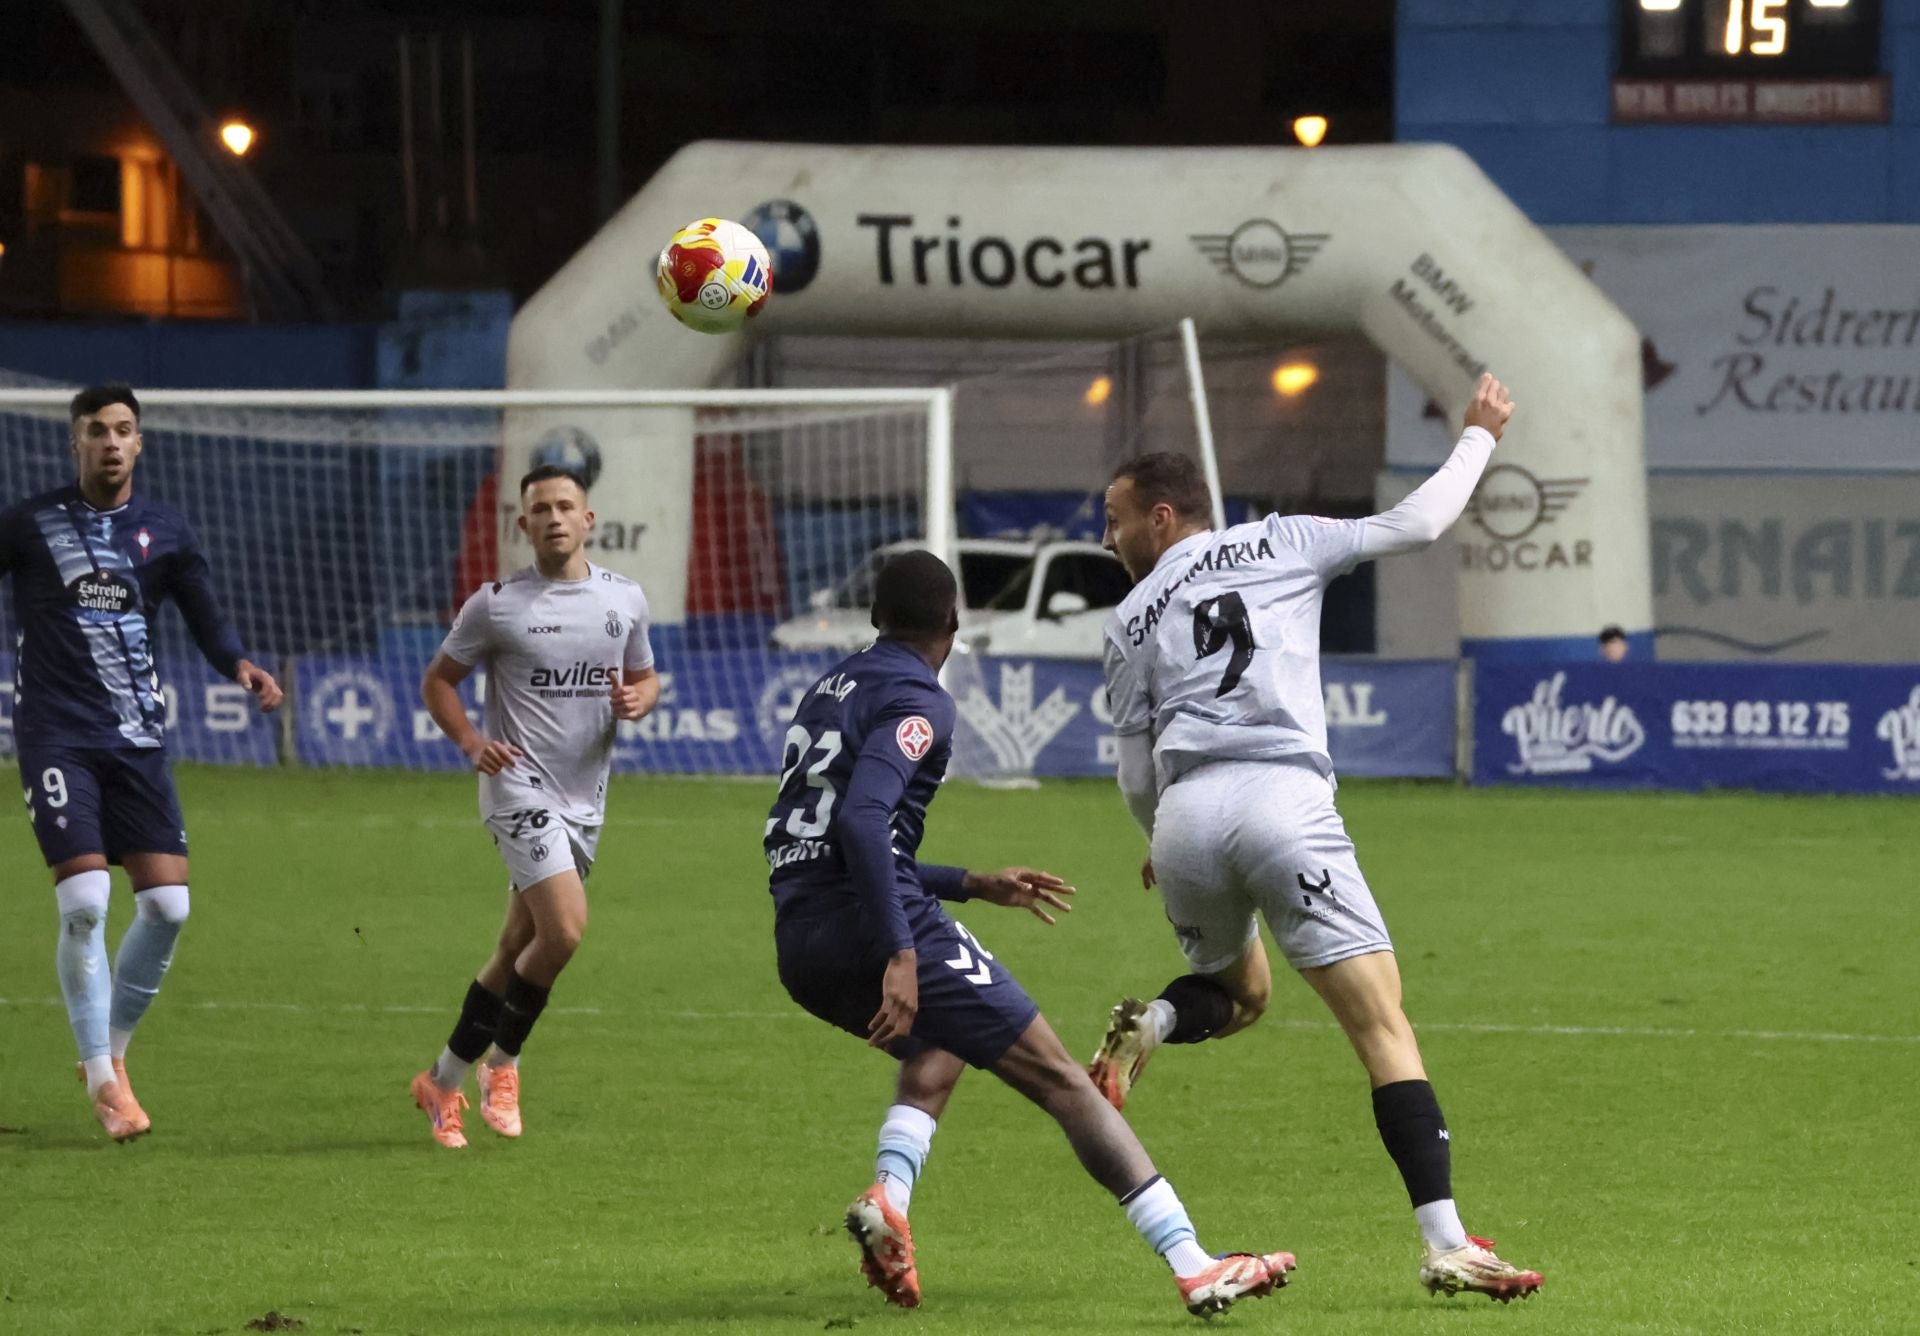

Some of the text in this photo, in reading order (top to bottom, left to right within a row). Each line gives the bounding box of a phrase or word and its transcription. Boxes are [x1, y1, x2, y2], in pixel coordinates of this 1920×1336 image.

[1724, 0, 1788, 55] 15
[857, 213, 1152, 288] Triocar
[1410, 252, 1474, 316] BMW
[1699, 352, 1920, 414] Restau
[78, 581, 128, 599] Estrella
[79, 593, 122, 610] Galicia
[528, 625, 562, 635] NOONE
[1193, 590, 1255, 698] 9
[530, 661, 618, 687] avilés
[1672, 700, 1727, 735] 633
[1777, 702, 1809, 735] 12
[1815, 702, 1849, 735] 75
[42, 766, 69, 808] 9
[764, 724, 843, 838] 23
